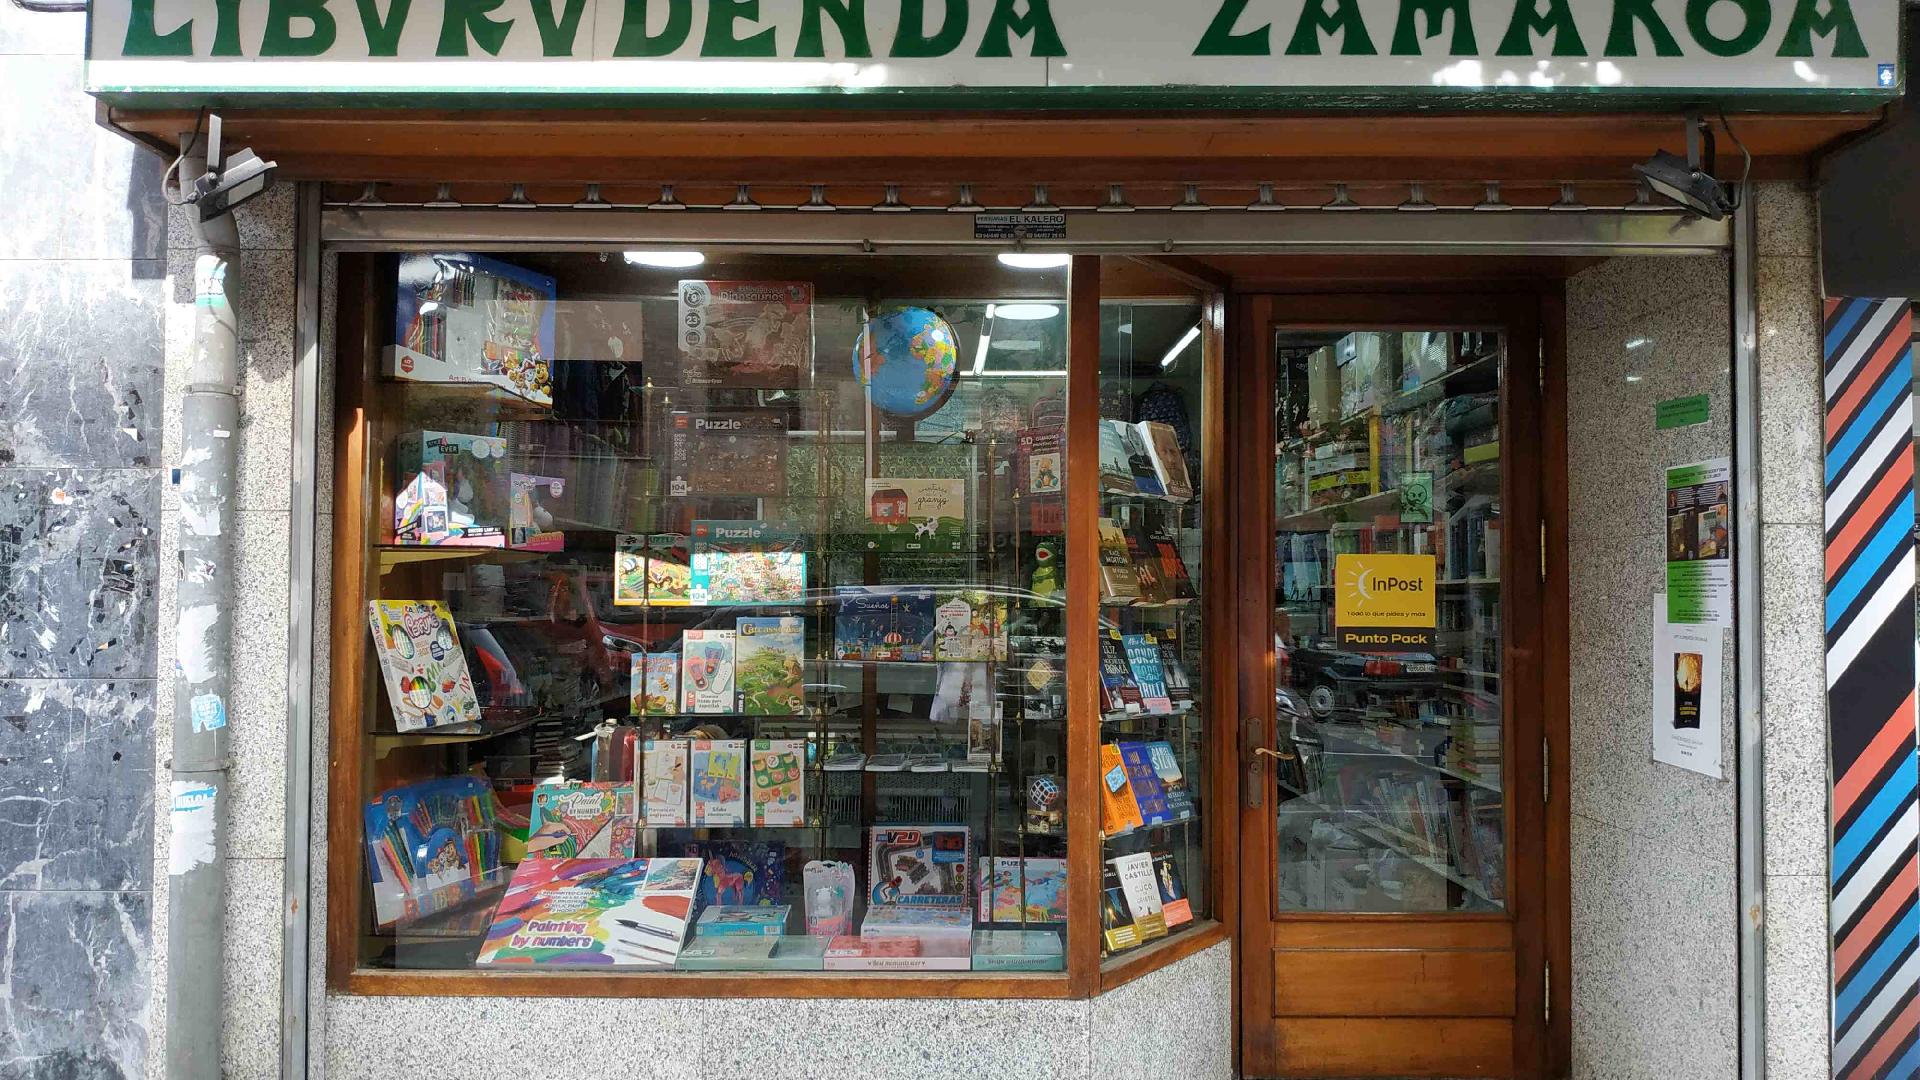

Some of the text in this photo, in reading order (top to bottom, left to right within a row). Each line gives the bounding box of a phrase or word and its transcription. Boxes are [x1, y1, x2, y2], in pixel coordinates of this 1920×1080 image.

[1192, 0, 1869, 57] ZAMAKOA
[1009, 215, 1021, 223] EL
[1024, 215, 1064, 223] KALERO
[720, 292, 785, 301] Dinosaurios
[686, 316, 697, 324] 23
[695, 418, 742, 430] Puzzle
[1020, 436, 1033, 446] 5D
[715, 527, 761, 539] Puzzle
[1372, 577, 1424, 592] InPost
[1345, 633, 1428, 644] Punto Pack
[1152, 755, 1178, 769] SILVA
[1127, 861, 1149, 871] JAVIER
[1124, 869, 1153, 880] CASTILLO
[897, 895, 965, 905] CARRETERAS
[527, 921, 587, 935] Painting
[511, 934, 592, 948] by numbers
